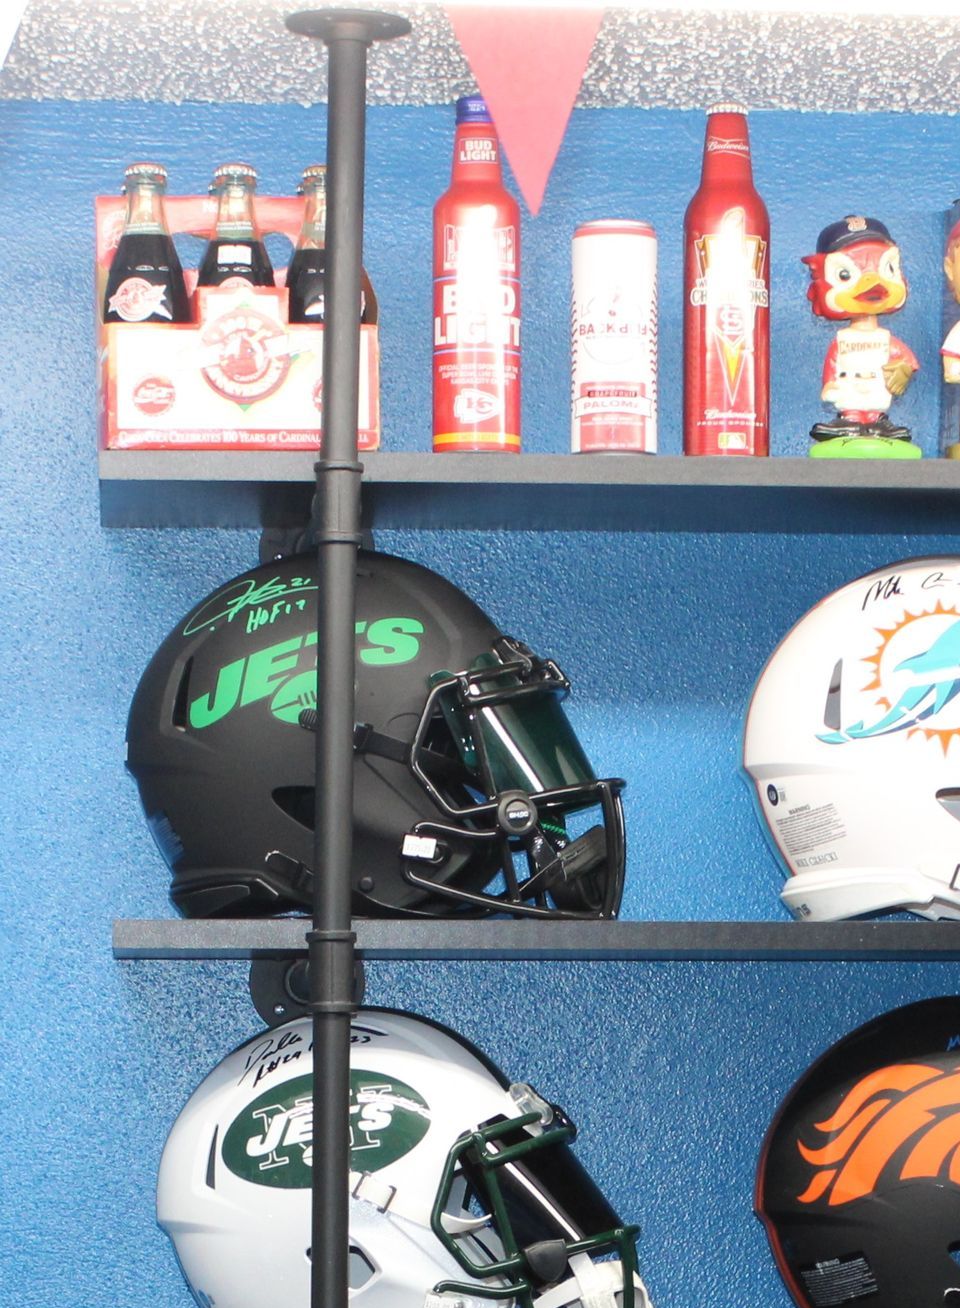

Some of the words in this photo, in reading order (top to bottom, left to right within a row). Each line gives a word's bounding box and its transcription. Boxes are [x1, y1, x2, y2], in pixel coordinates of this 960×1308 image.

[465, 139, 492, 151] BUD
[460, 150, 496, 161] LIGHT
[443, 283, 516, 315] BD
[278, 430, 322, 443] CARDINAL
